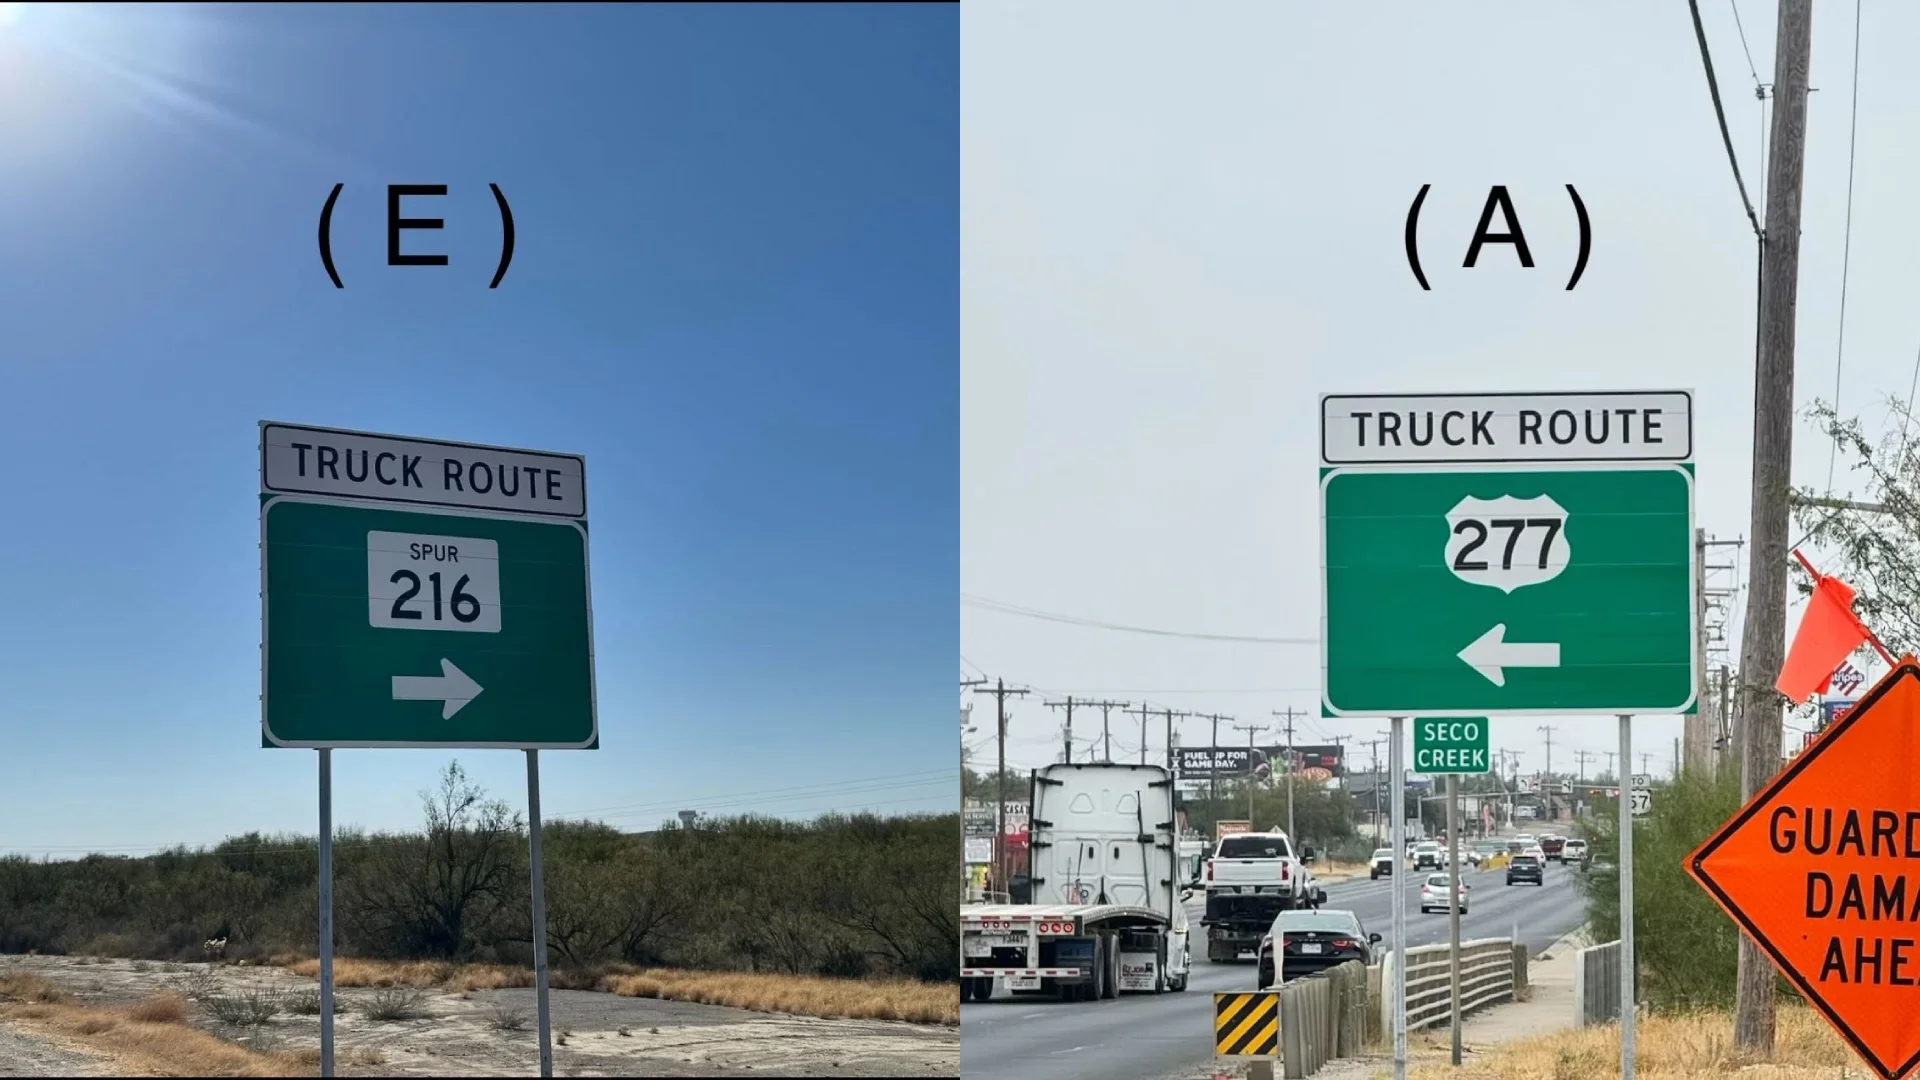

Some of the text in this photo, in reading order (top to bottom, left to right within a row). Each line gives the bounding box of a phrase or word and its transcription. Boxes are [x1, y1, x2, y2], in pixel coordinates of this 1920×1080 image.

[1350, 408, 1663, 447] TRUCK ROUTE
[291, 442, 563, 501] TRUCK ROUTE
[410, 542, 459, 563] SPUR
[1453, 518, 1562, 571] 277
[389, 569, 481, 623] 216
[1424, 722, 1479, 741] SECO
[1184, 751, 1210, 760] FUEL
[1227, 751, 1248, 760] FOR
[1184, 760, 1213, 769] GAME
[1417, 748, 1485, 767] CREEK
[1631, 777, 1645, 786] TO
[1004, 805, 1024, 814] CASA
[1819, 936, 1920, 986] AHE
